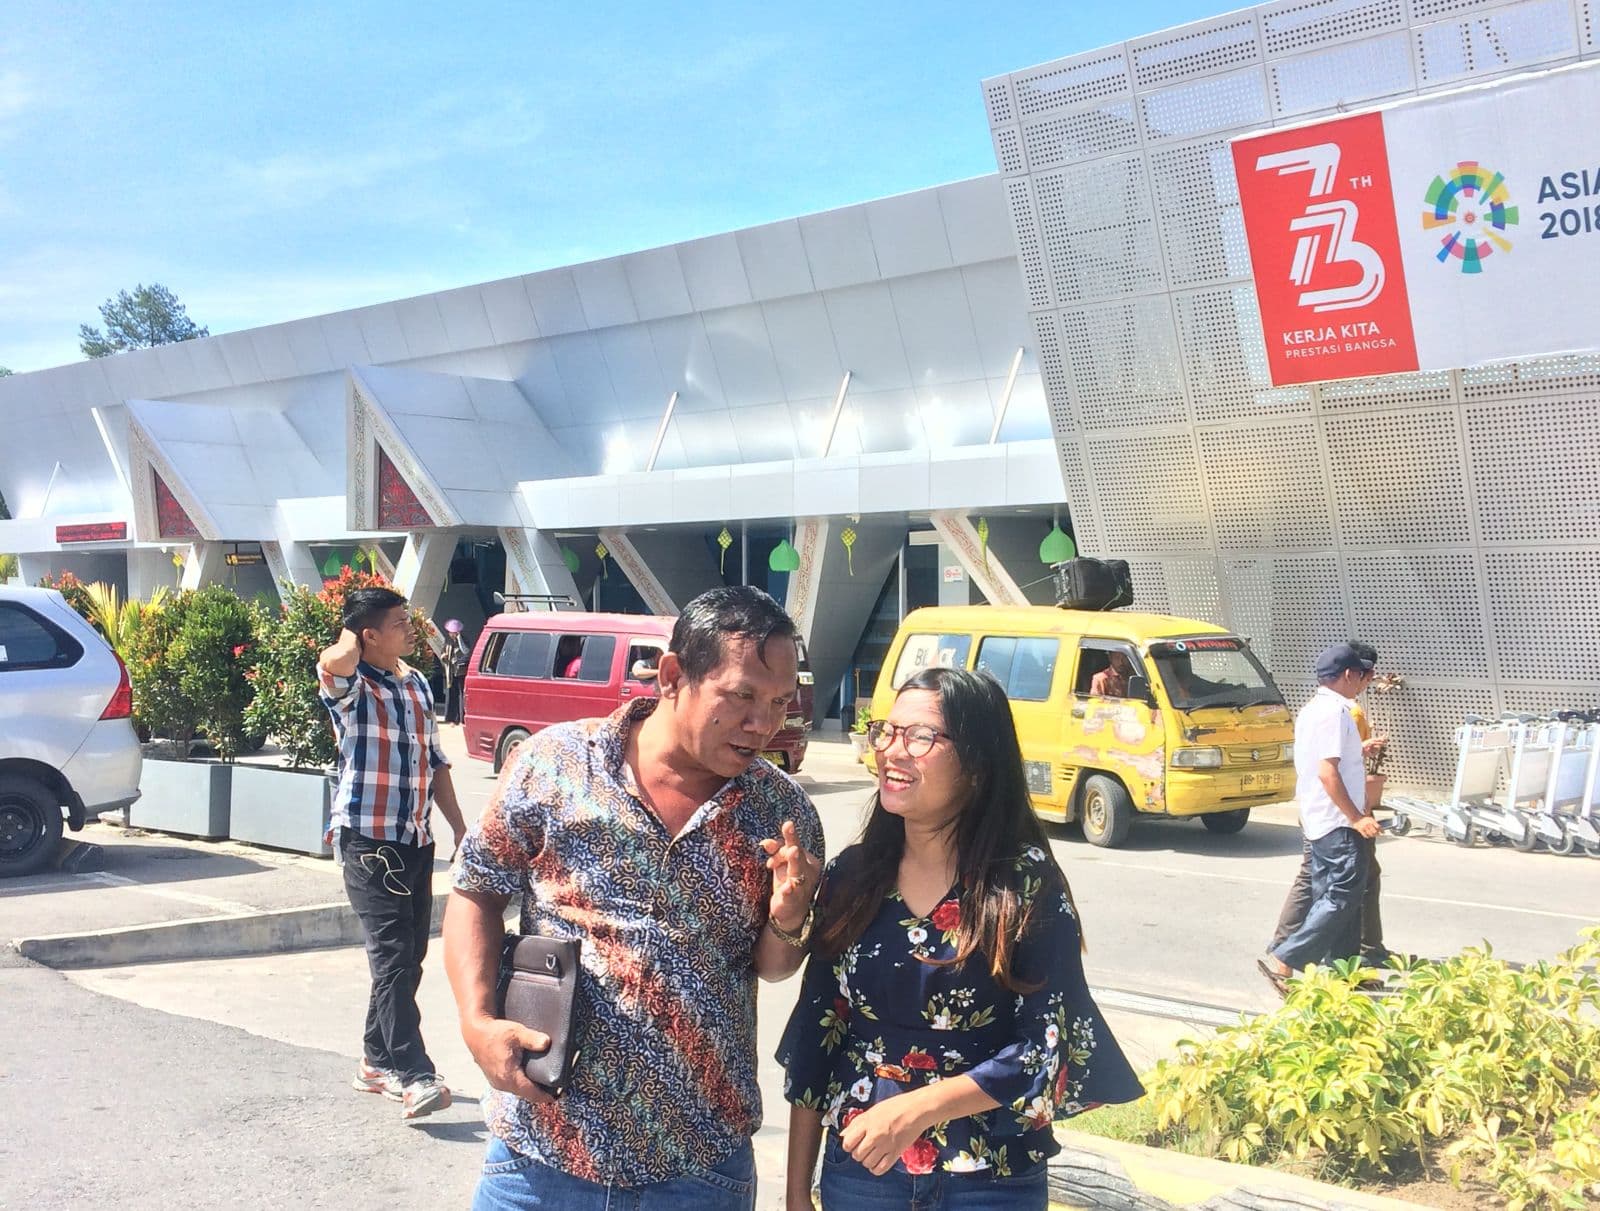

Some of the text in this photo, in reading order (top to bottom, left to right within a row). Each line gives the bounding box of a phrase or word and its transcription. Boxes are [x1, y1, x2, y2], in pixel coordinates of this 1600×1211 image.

[1349, 174, 1373, 190] TH
[1539, 204, 1600, 240] 201
[1282, 321, 1381, 345] KERJA KITA
[1285, 338, 1397, 359] PRESTASI BANGSA
